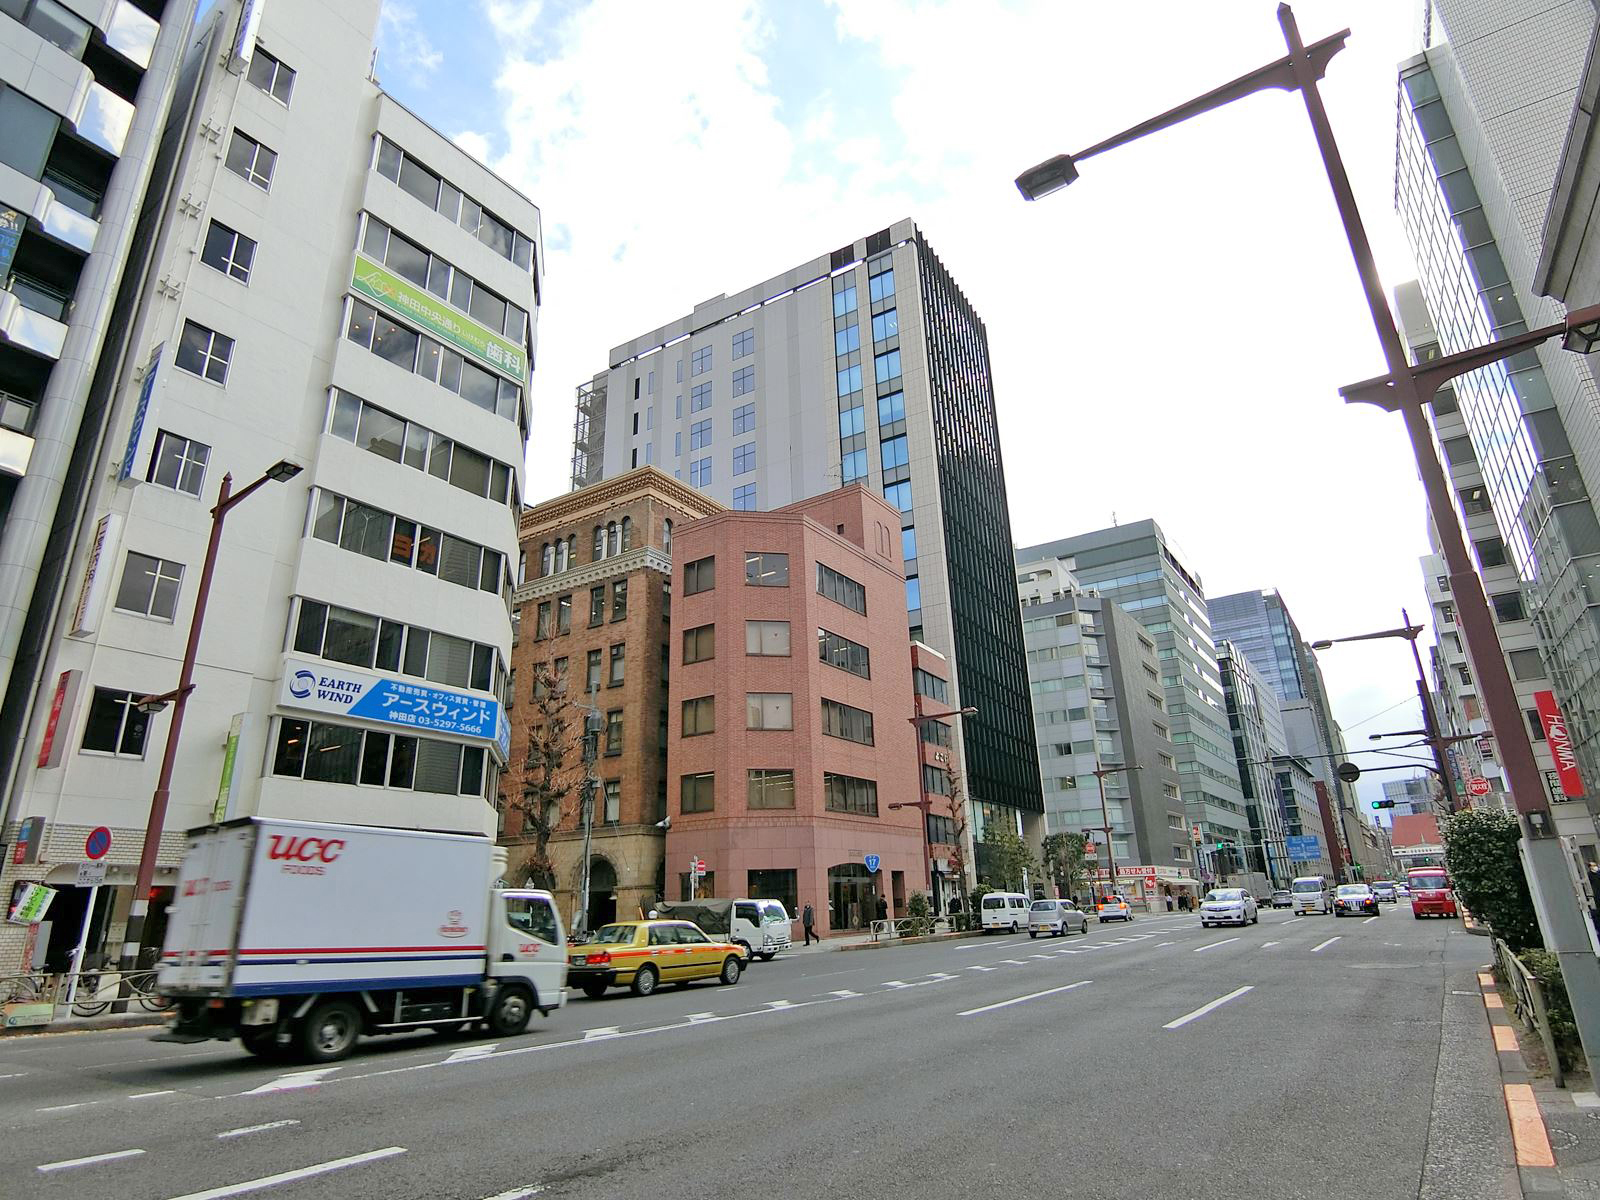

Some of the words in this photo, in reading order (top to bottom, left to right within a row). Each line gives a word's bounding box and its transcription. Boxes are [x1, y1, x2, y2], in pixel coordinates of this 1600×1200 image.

[486, 341, 520, 374] 歯科
[317, 689, 353, 705] WIND
[318, 677, 362, 694] EARTH
[382, 692, 490, 725] アースウィンド
[389, 710, 416, 724] 神田店
[418, 716, 482, 734] 03-5297-5666
[1545, 714, 1577, 771] HONMA
[268, 834, 346, 863] UCC
[868, 858, 877, 866] 17
